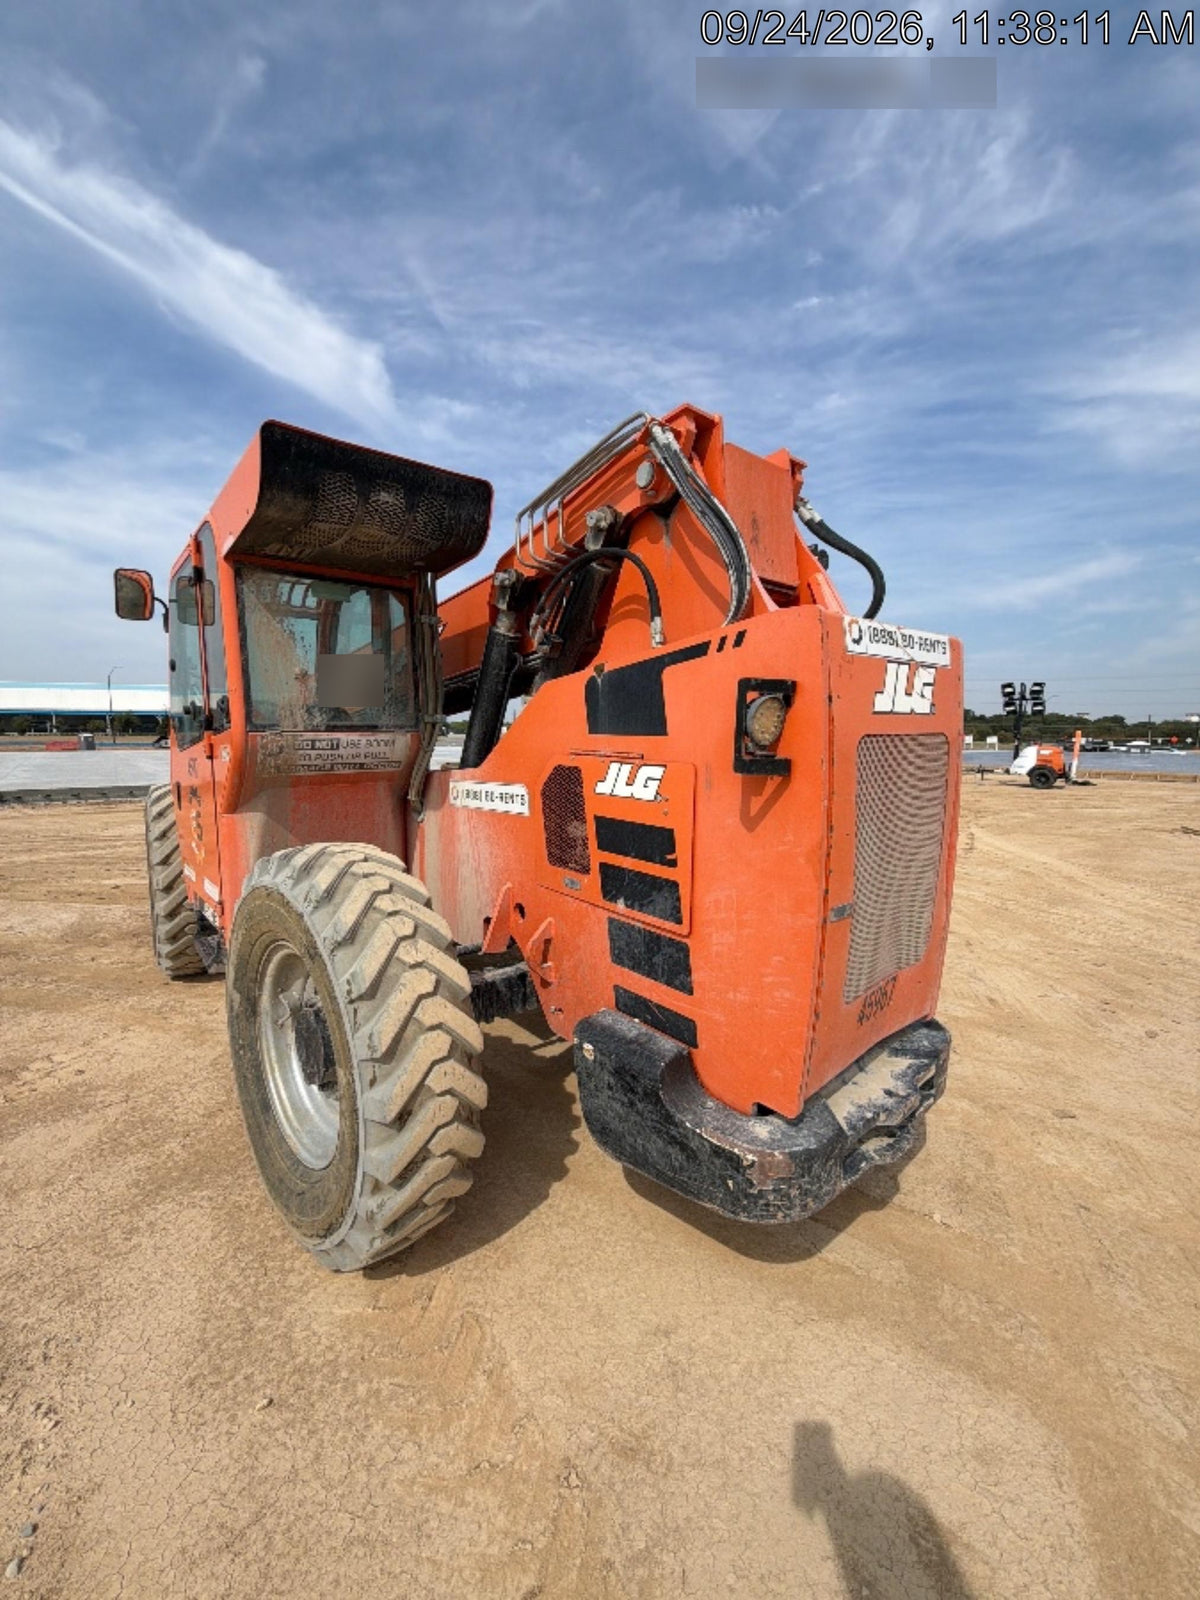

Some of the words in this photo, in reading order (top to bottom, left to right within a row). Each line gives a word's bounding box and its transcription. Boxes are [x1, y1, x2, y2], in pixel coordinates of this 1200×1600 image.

[872, 660, 936, 715] JLG
[314, 739, 338, 749] NOT
[341, 738, 361, 749] USE
[314, 752, 344, 761] PUSH
[364, 751, 390, 760] PULL
[594, 761, 666, 801] JLG
